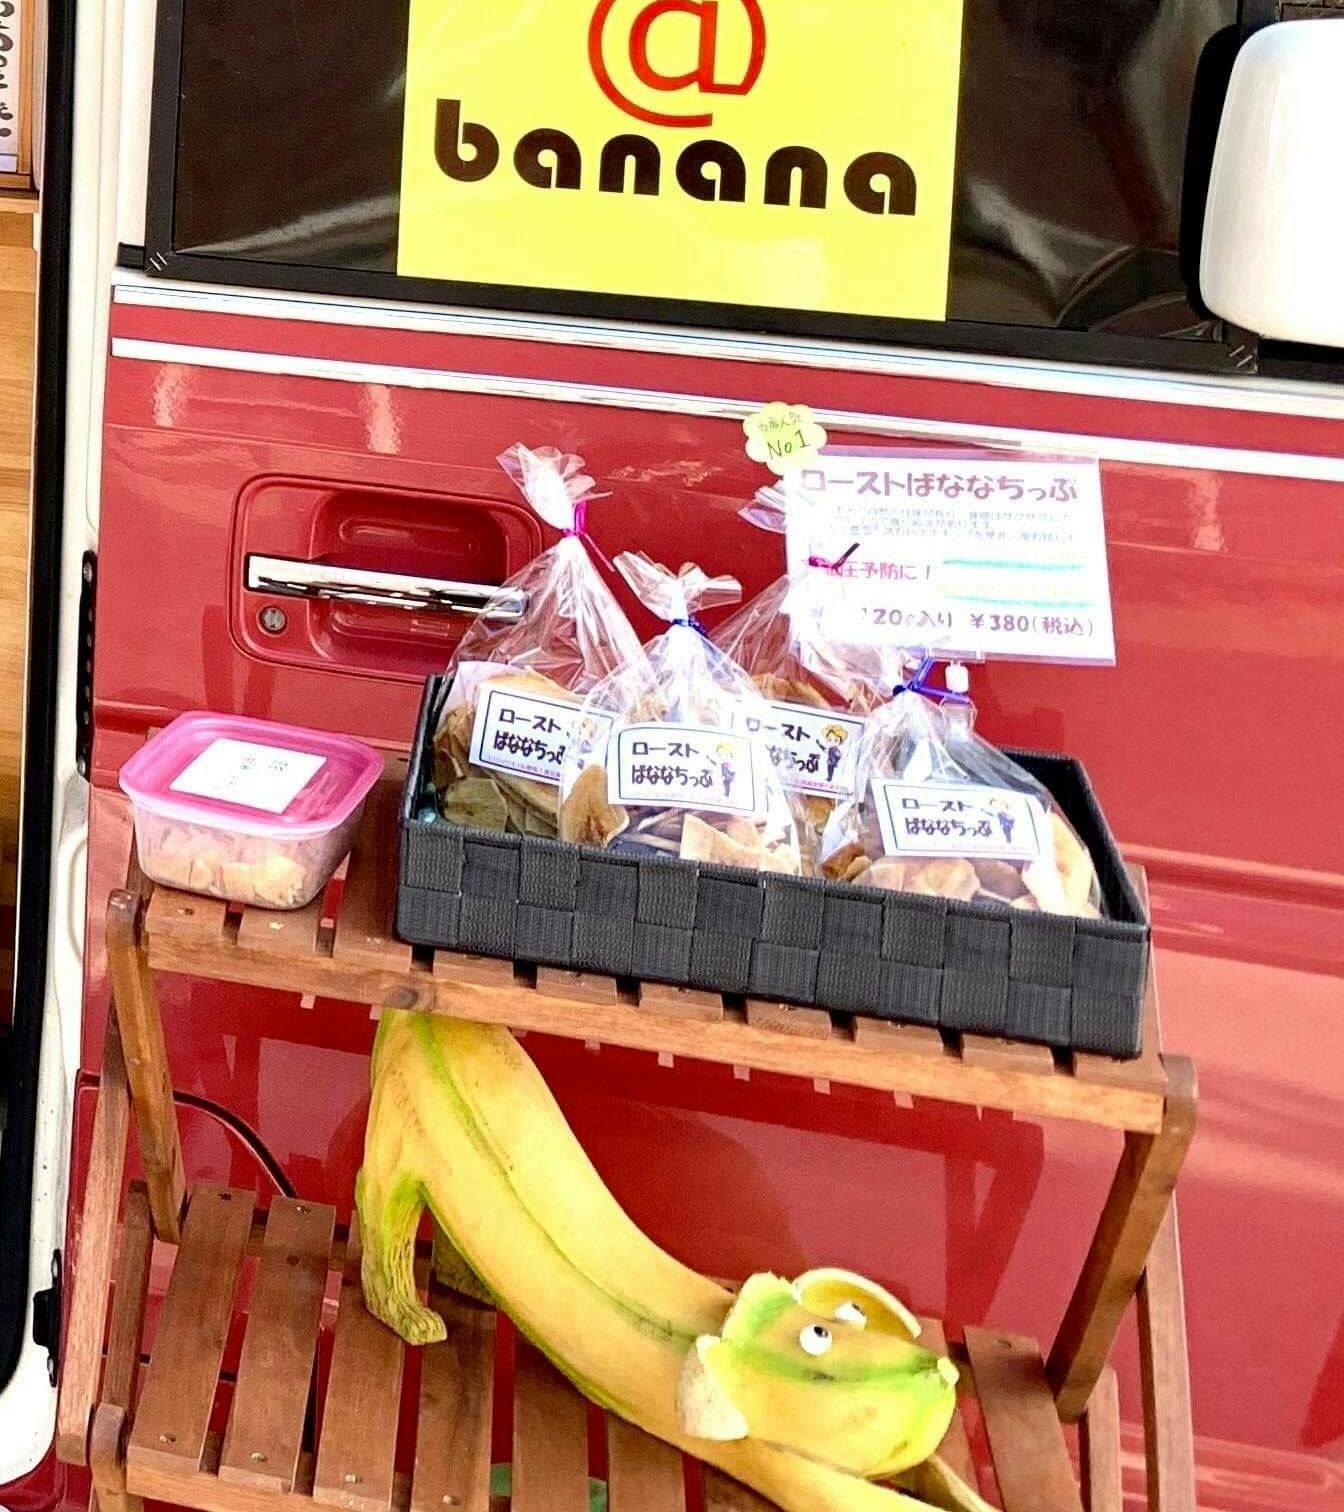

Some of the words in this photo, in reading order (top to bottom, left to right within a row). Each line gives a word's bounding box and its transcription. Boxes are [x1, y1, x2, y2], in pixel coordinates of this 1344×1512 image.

[433, 98, 918, 217] banana
[498, 708, 562, 734] ロースト
[631, 741, 700, 759] ロースト
[901, 797, 974, 813] ロースト
